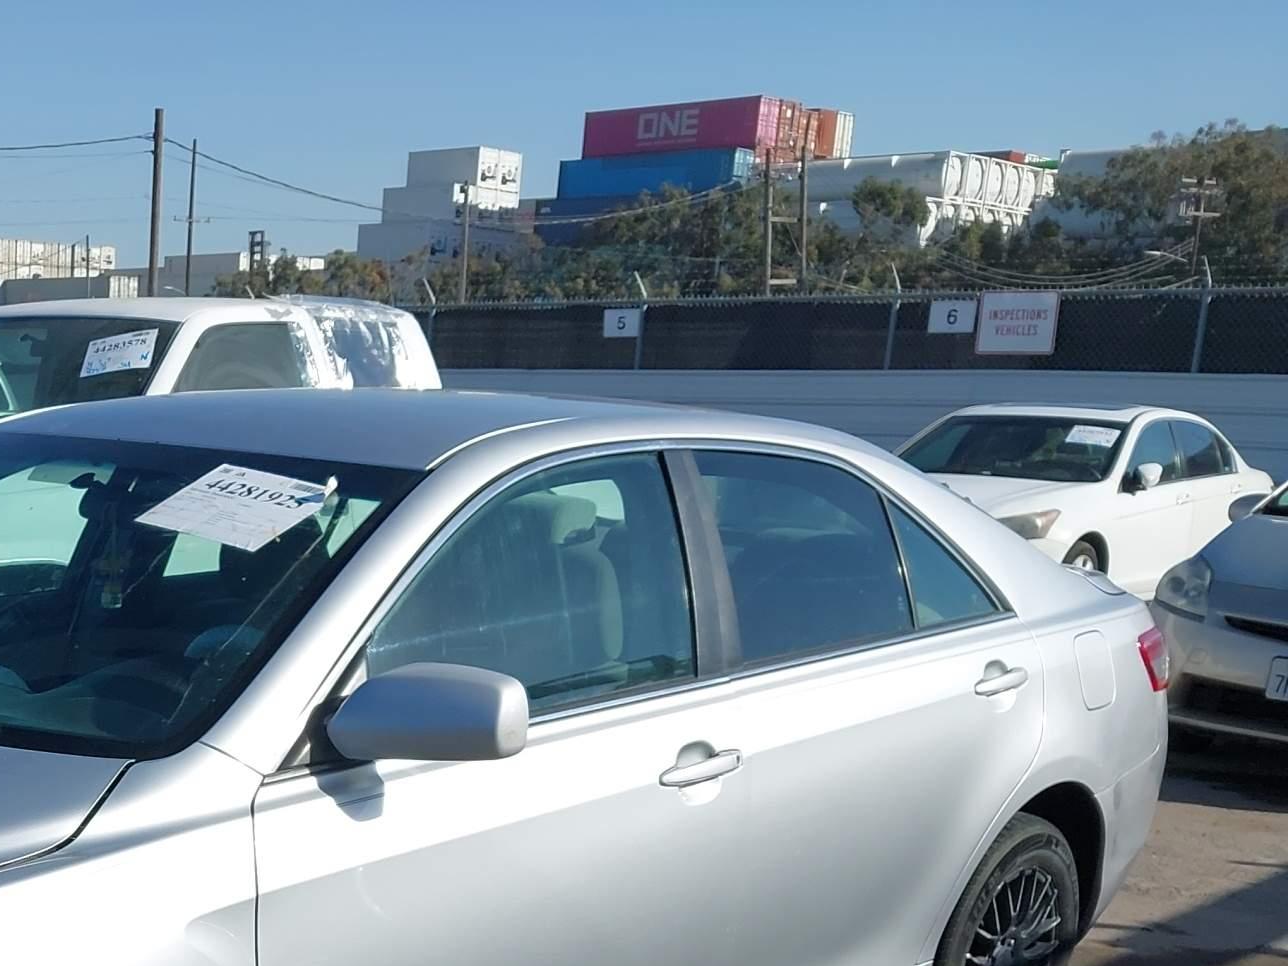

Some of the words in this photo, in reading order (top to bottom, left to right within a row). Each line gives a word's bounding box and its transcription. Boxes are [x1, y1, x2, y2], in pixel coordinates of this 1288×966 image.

[637, 109, 699, 139] ONE
[946, 309, 958, 325] 6
[988, 309, 1049, 321] INSPECTIONS
[616, 316, 627, 331] 5
[994, 324, 1039, 337] VEHICLES
